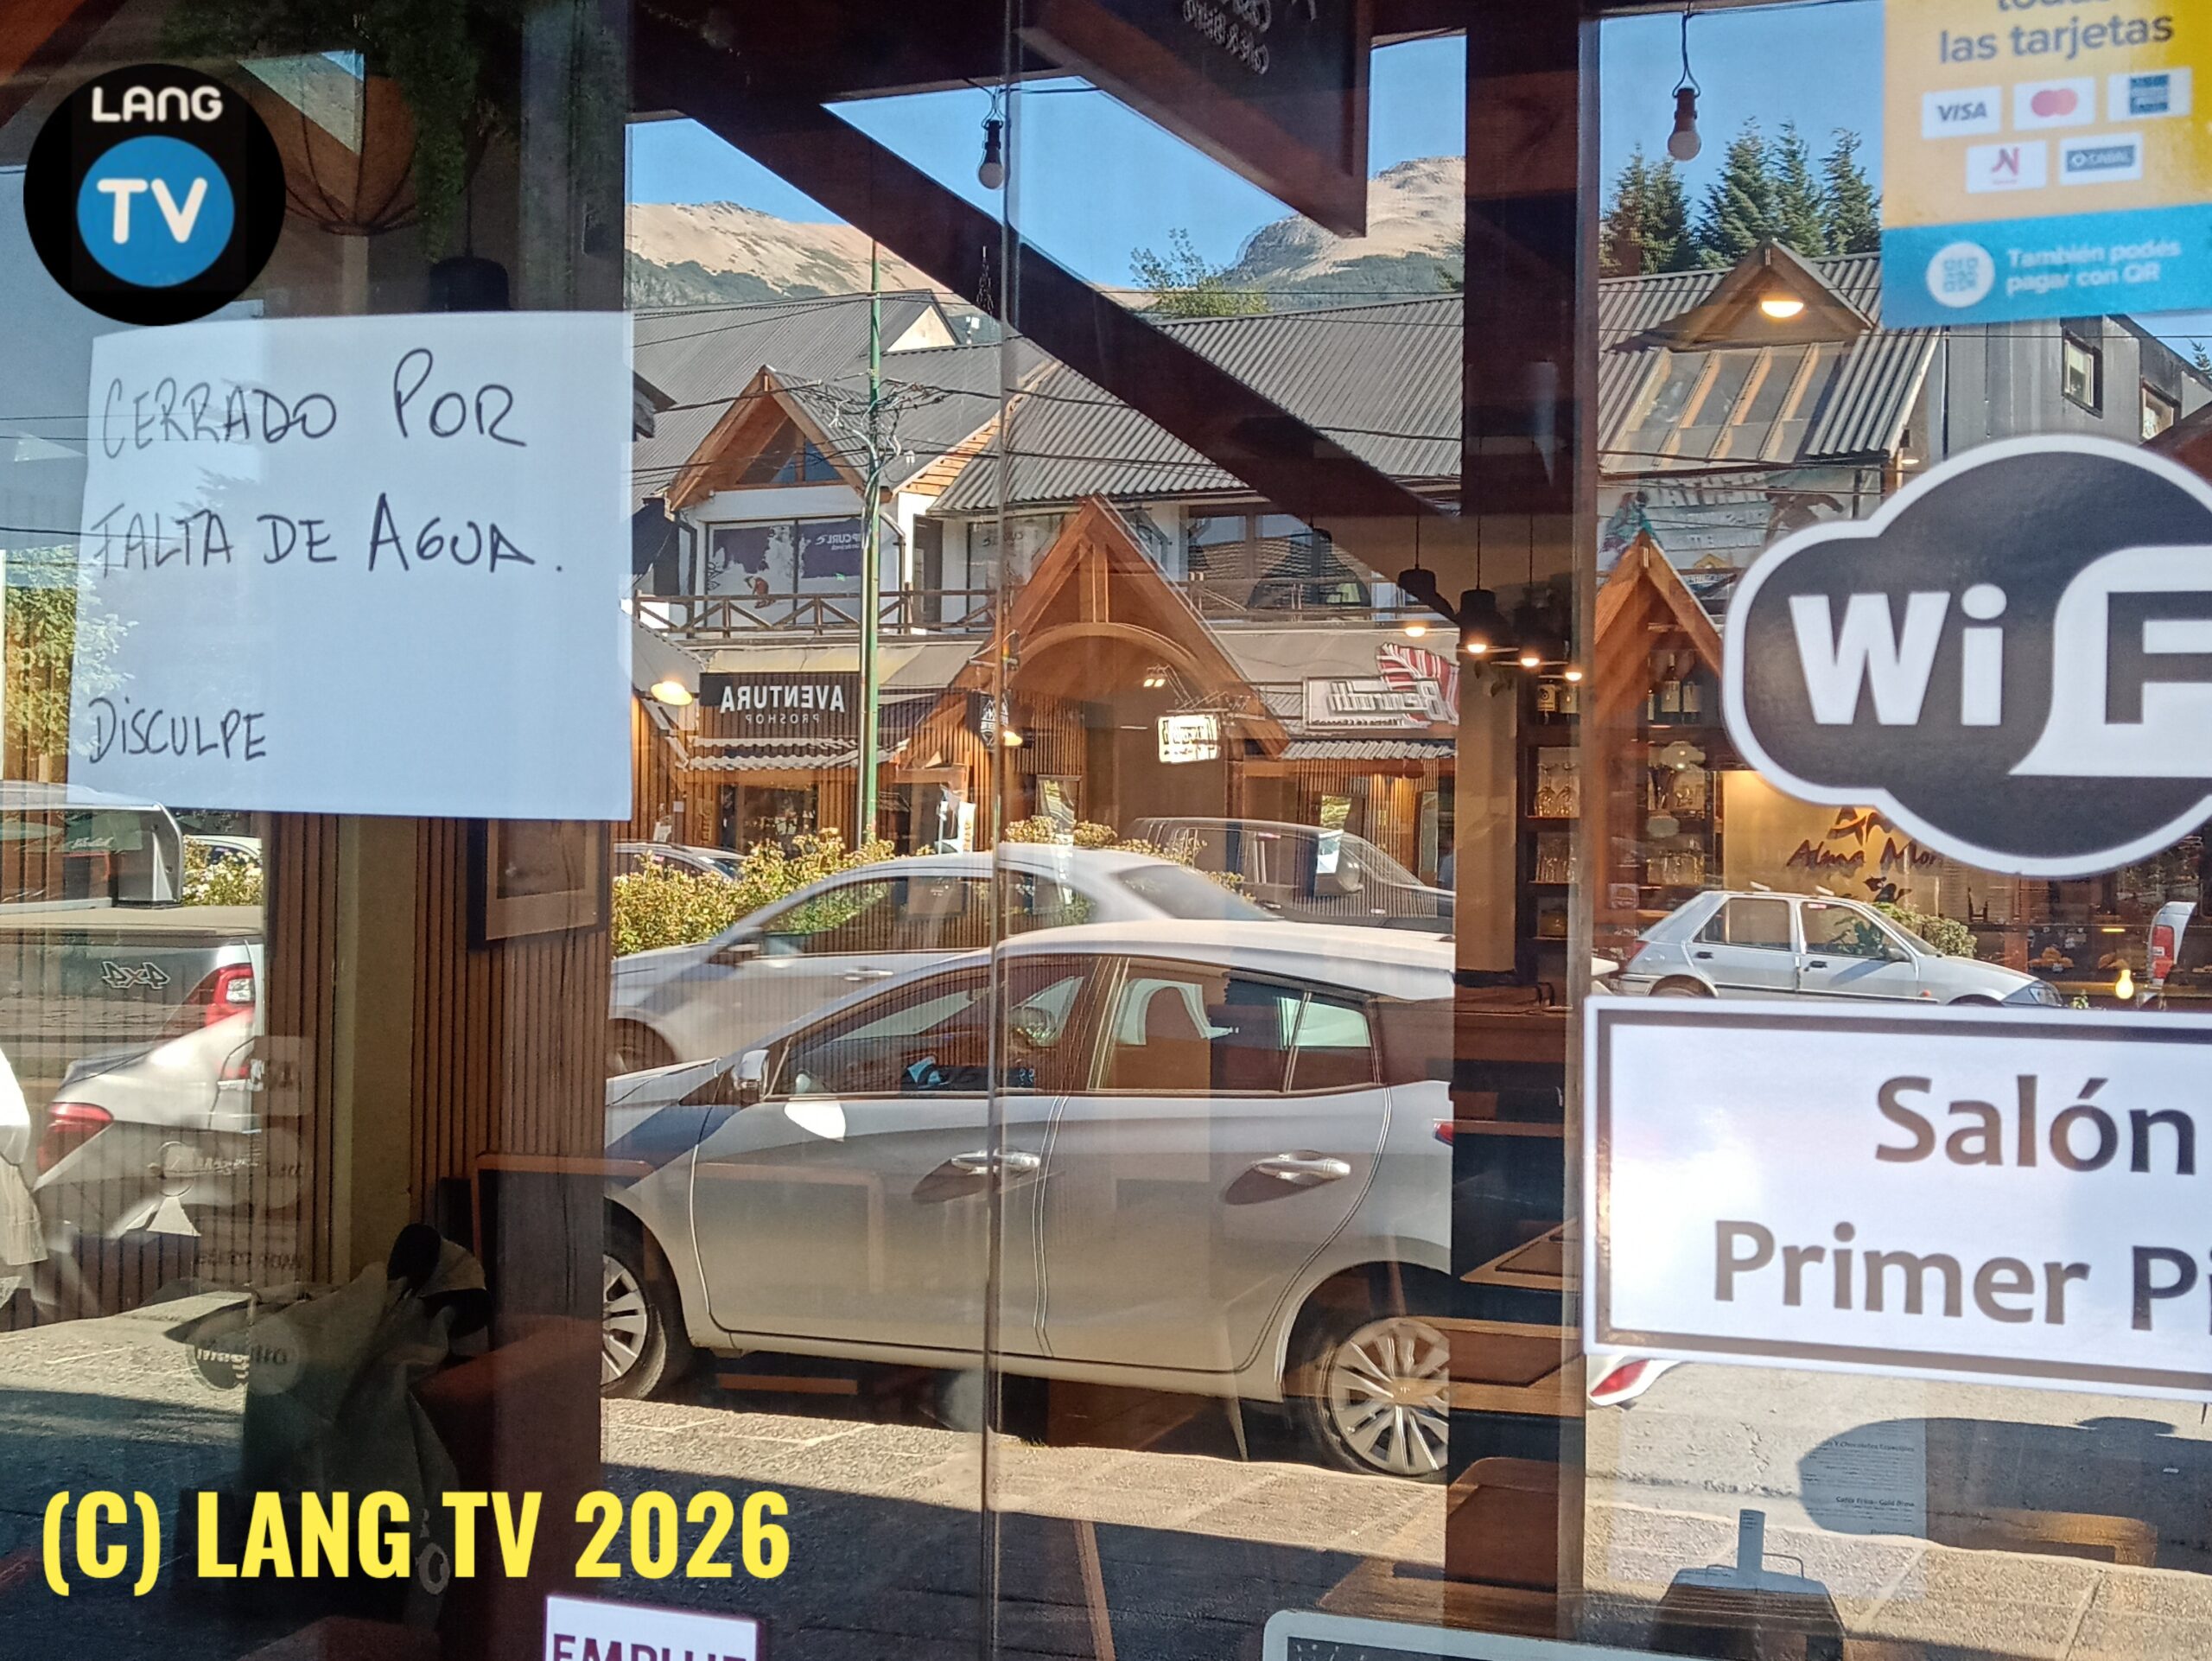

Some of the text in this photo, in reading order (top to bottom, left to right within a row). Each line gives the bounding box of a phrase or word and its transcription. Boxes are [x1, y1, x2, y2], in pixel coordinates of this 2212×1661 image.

[1940, 15, 2174, 64] las tarjetas
[1938, 102, 1986, 122] VISA
[2005, 263, 2160, 297] pagar con QR
[2006, 245, 2105, 268] También
[103, 349, 526, 458] CERRADO POR
[92, 503, 233, 578] FALTA
[257, 514, 336, 563] DE
[1786, 839, 1865, 869] Alma
[1875, 1073, 2196, 1175] Salón
[1713, 1221, 2090, 1326] Primer
